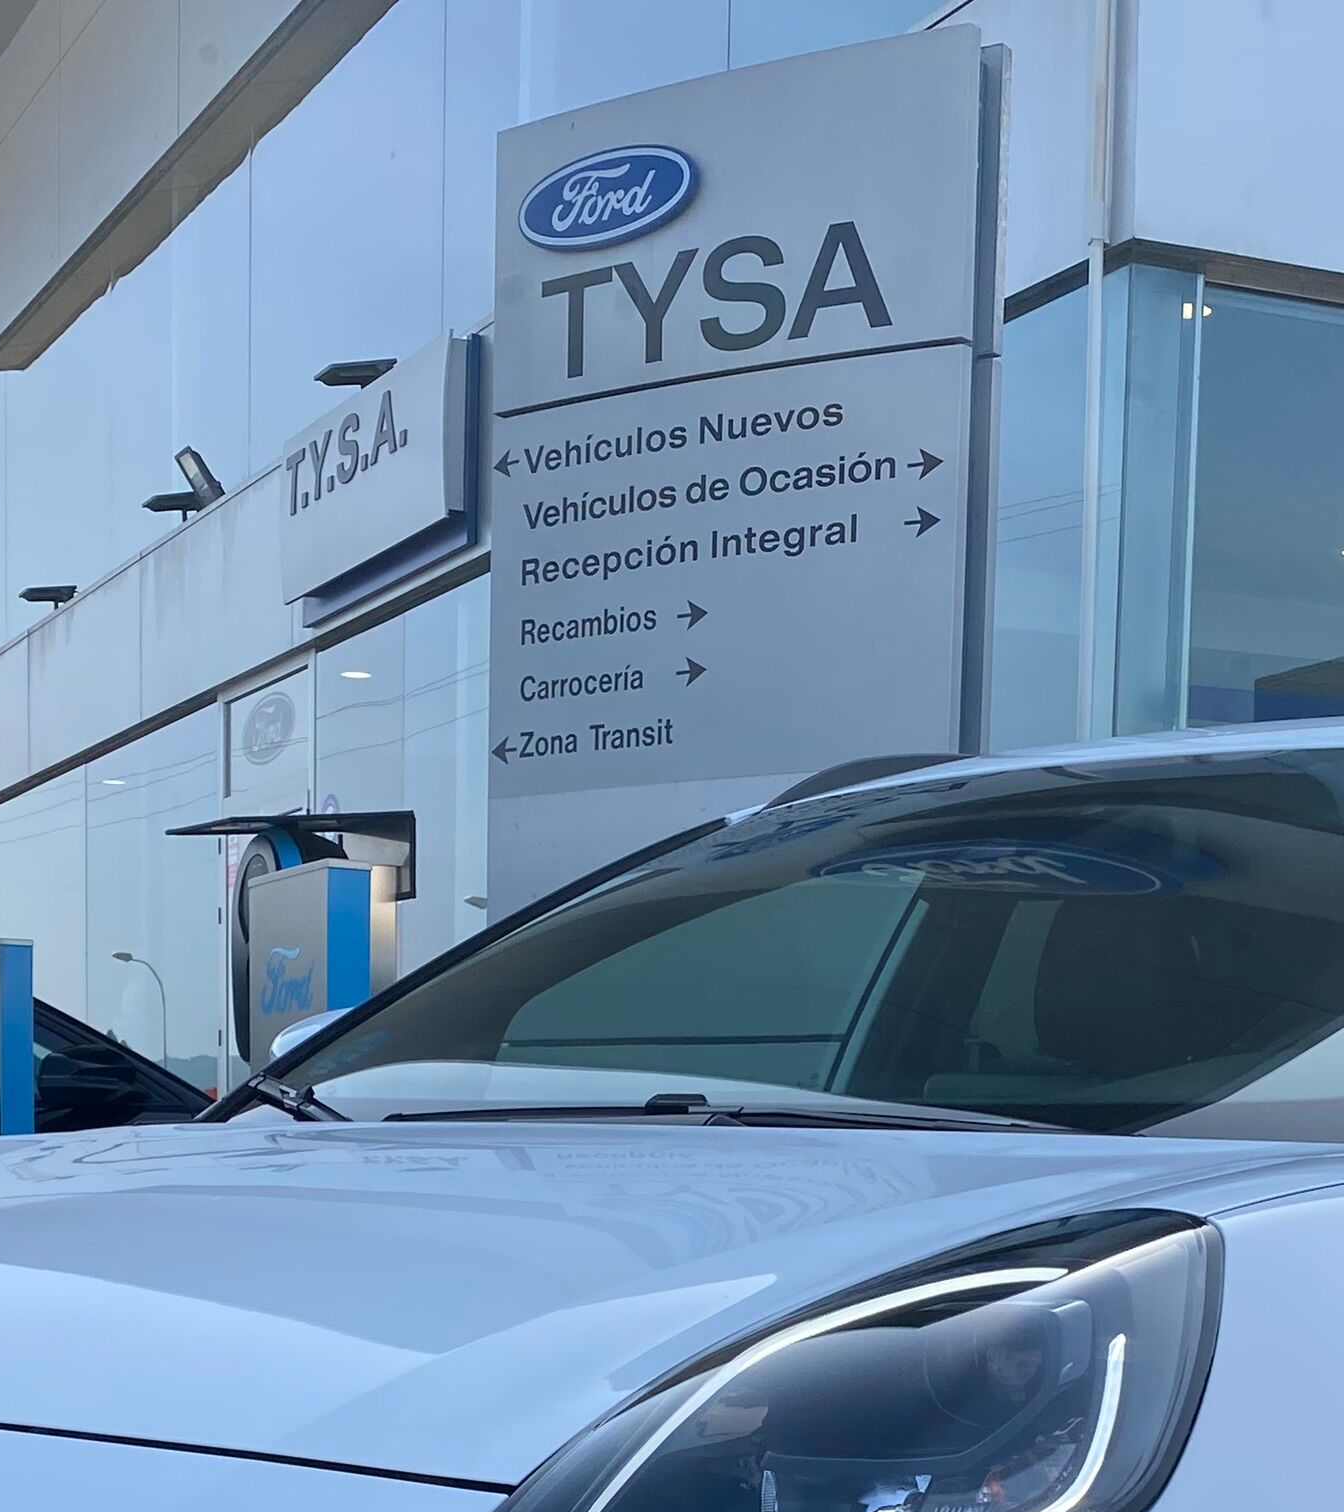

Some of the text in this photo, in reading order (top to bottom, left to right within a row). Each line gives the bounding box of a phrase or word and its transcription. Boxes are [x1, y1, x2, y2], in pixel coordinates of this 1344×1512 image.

[552, 163, 656, 232] Ford
[541, 221, 893, 378] TYSA
[286, 390, 408, 516] T.Y.S.A.
[524, 401, 844, 474] Vehículos Nuevos
[523, 451, 896, 530] Vehículos de Ocasión
[520, 513, 858, 586] Recepción Integral
[520, 606, 657, 646] Recambios
[520, 664, 644, 702] Carrocería
[519, 718, 673, 758] Zona Transit
